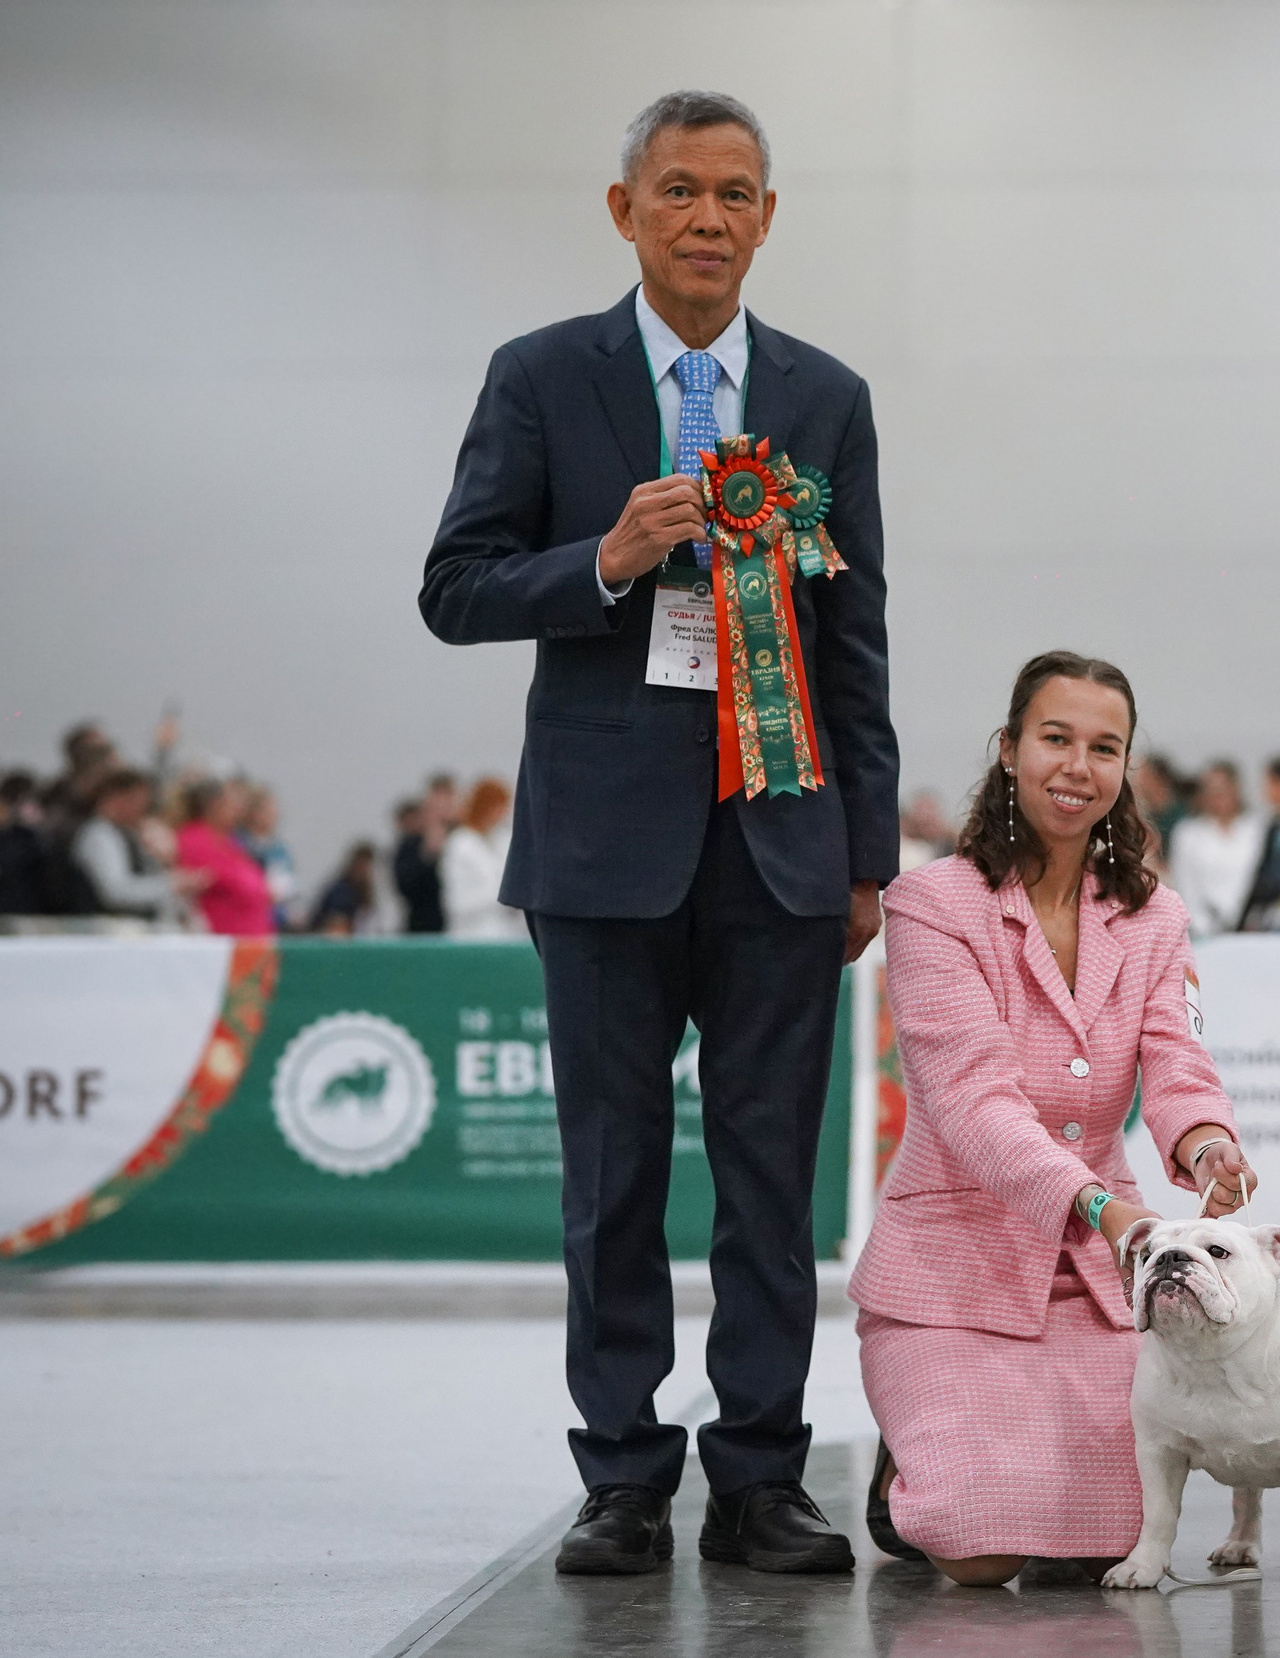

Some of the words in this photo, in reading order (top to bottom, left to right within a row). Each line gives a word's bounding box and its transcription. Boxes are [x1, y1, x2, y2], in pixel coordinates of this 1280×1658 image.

[667, 610, 696, 620] СУДЬЯ
[674, 633, 691, 641] Fred
[664, 672, 669, 680] 1
[689, 674, 695, 682] 2
